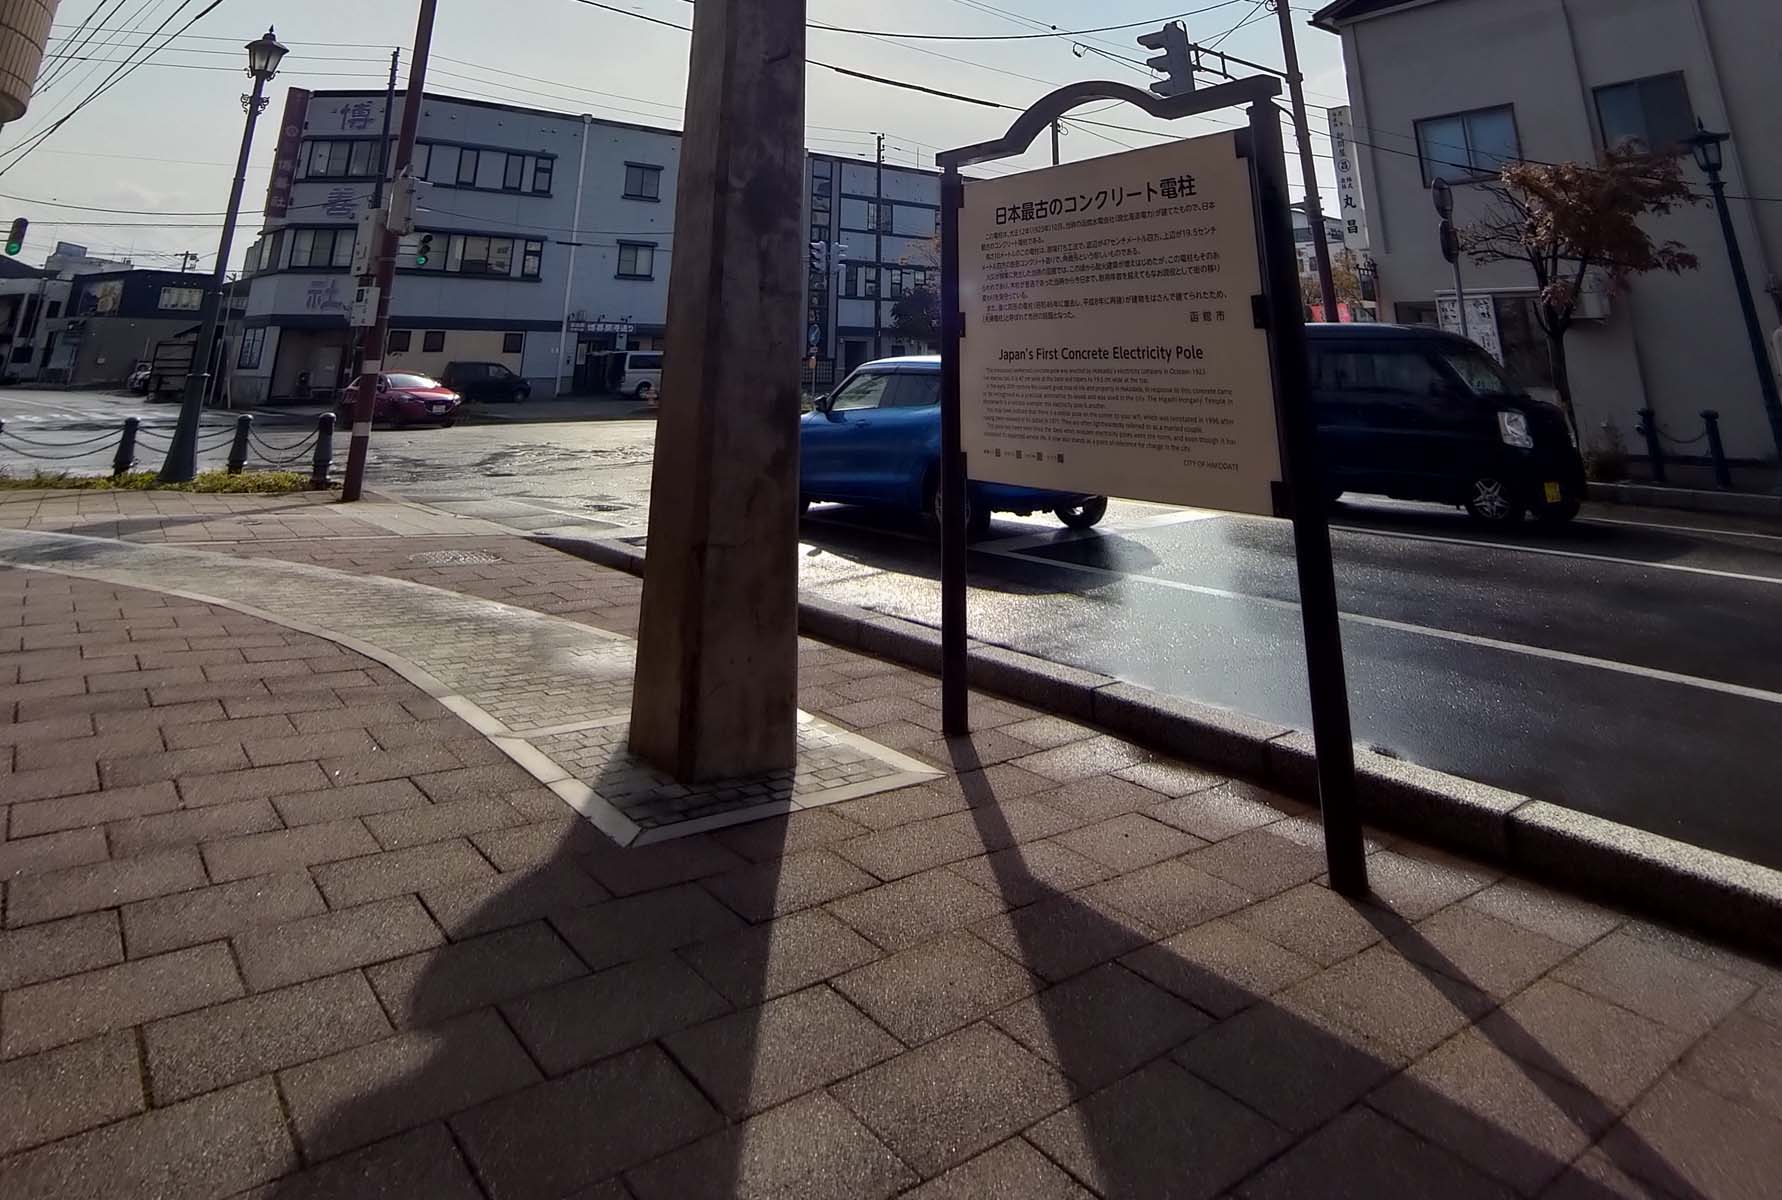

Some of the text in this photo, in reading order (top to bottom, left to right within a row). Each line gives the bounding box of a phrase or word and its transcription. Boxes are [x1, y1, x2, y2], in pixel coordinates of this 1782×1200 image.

[996, 174, 1197, 225] 日本最古のコンクリート電柱
[998, 345, 1204, 363] Japan's First Concrete Electricity Pole
